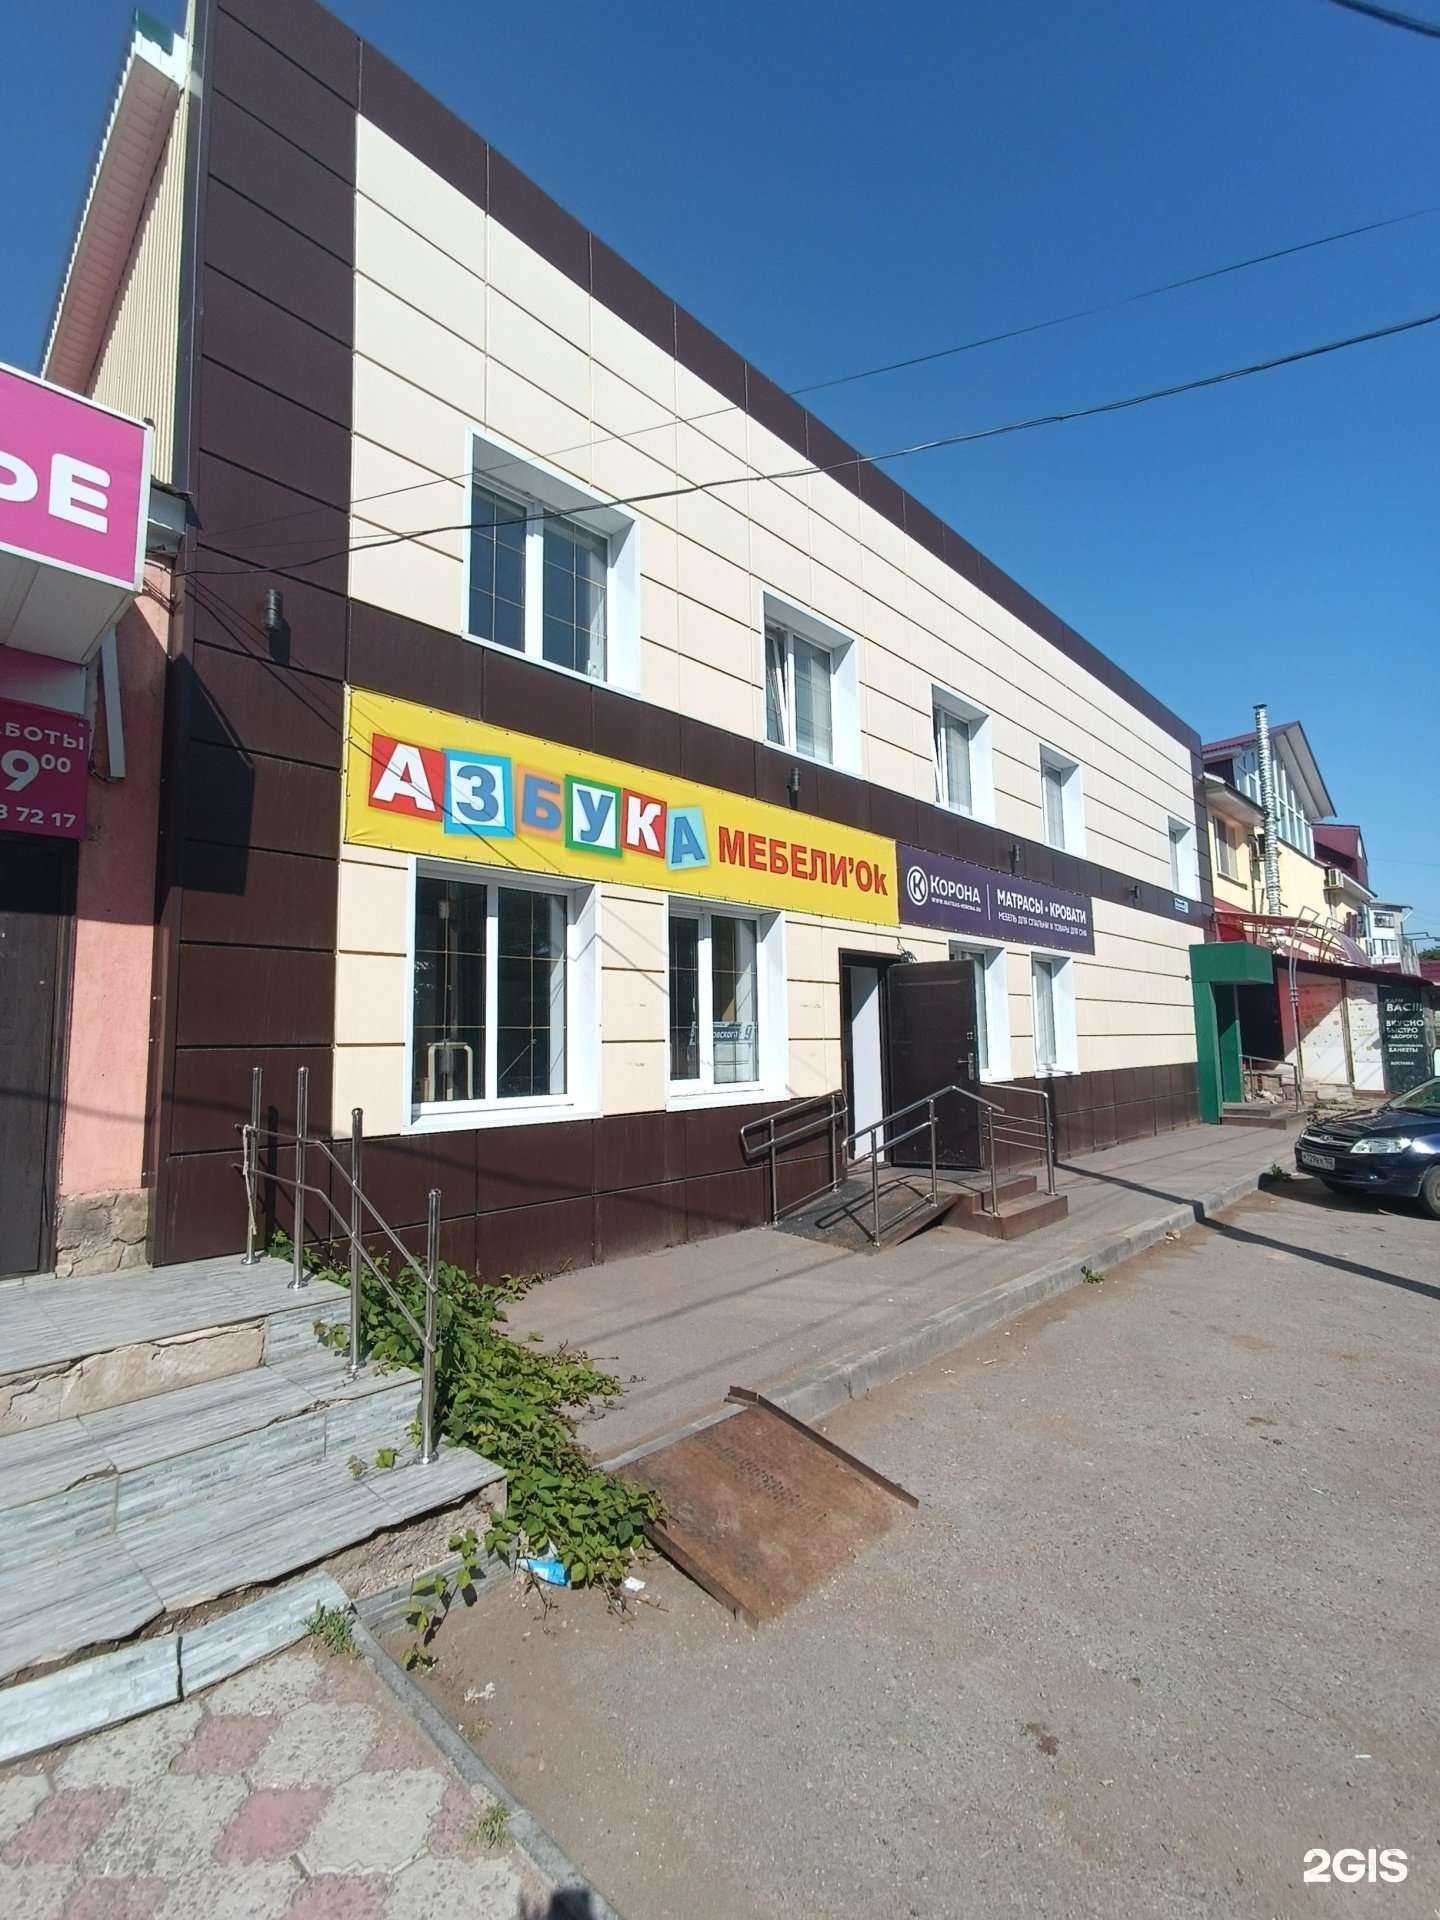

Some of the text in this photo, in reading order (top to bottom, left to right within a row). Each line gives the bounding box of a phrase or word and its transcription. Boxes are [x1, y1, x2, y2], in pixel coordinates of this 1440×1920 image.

[0, 722, 84, 751] БОТЫ
[16, 806, 44, 824] 72
[51, 812, 76, 828] 17
[372, 742, 706, 864] АЗБУКА
[930, 874, 981, 904] КОРОНА
[996, 888, 1087, 925] МАТРАСЫ КРОВАТИ
